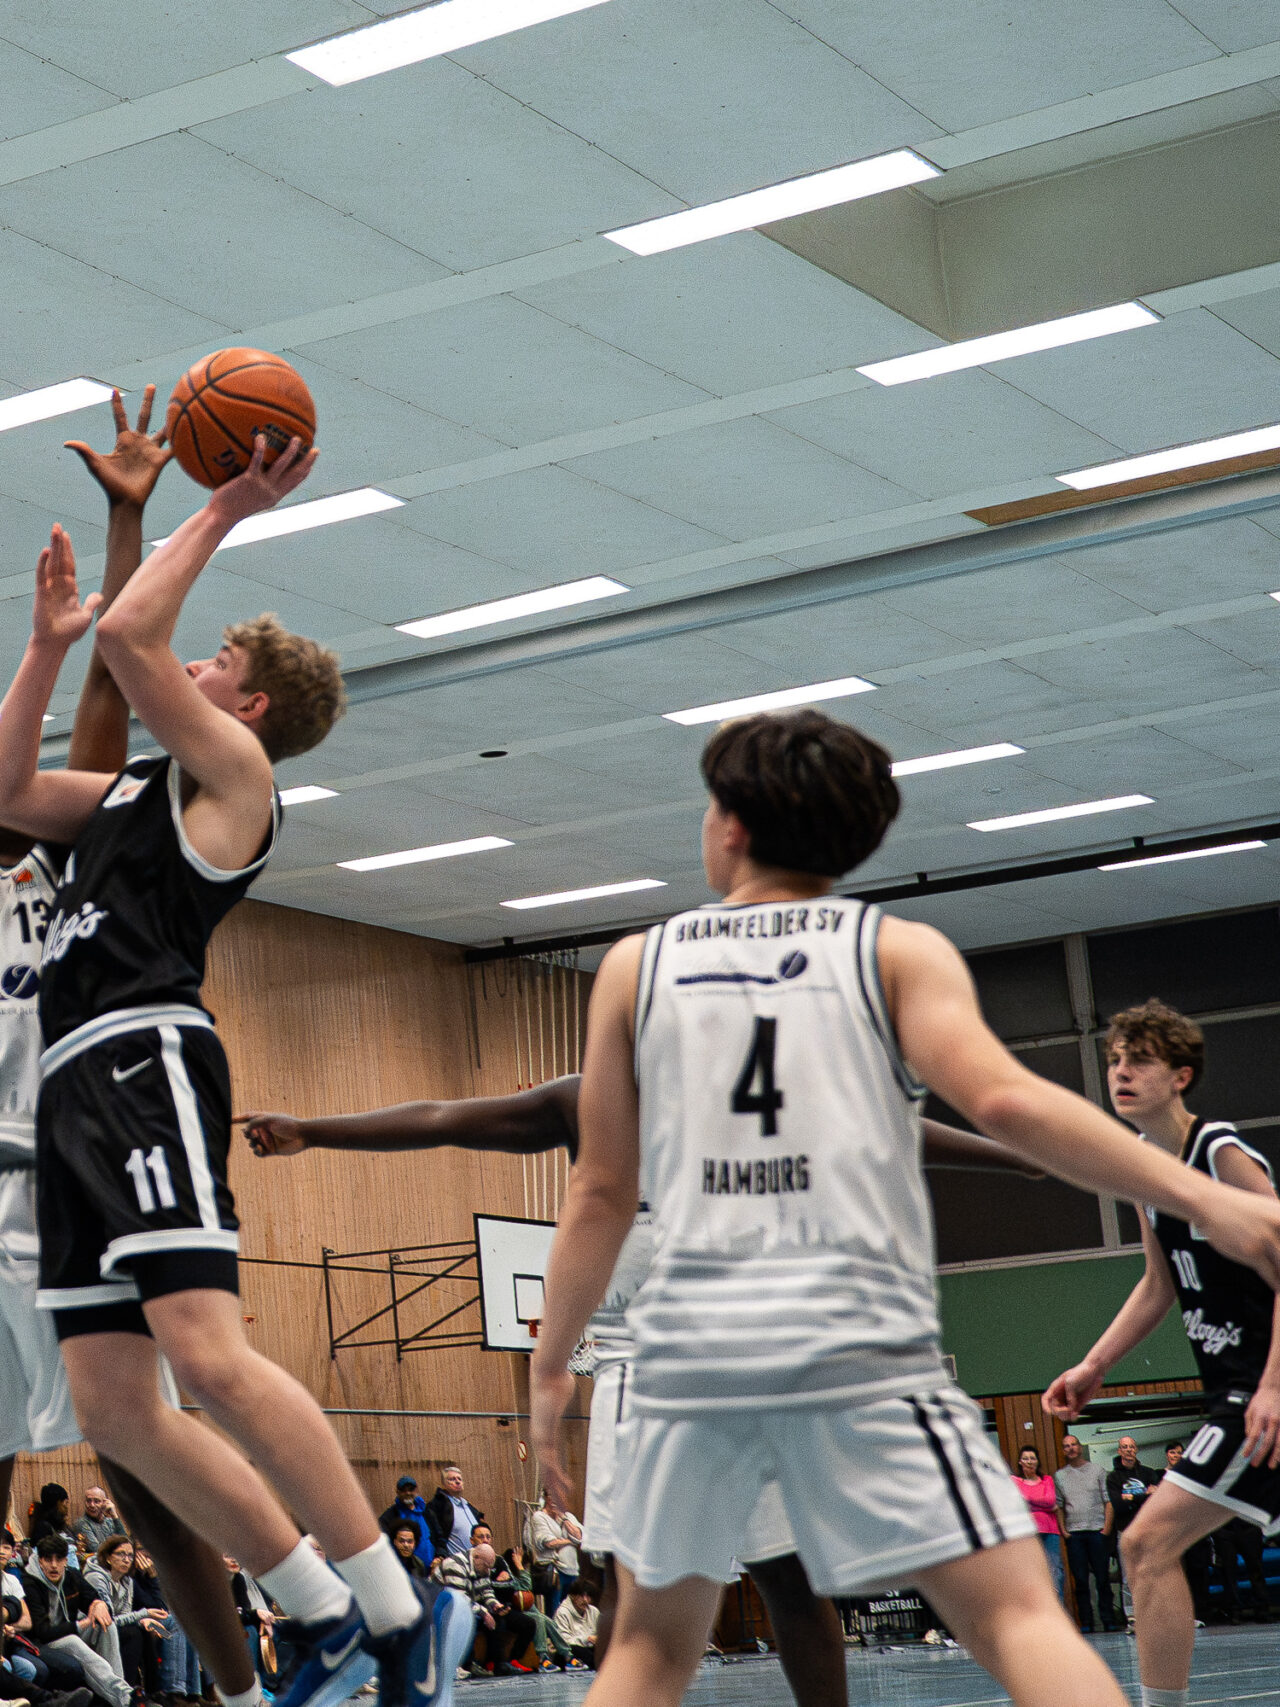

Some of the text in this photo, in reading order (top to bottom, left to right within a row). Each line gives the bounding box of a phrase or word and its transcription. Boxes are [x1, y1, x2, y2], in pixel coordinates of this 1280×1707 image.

[676, 908, 845, 943] BRAMFELDER SV
[730, 1015, 784, 1137] 4
[125, 1145, 177, 1214] 11
[702, 1154, 811, 1194] HAMBURG
[1171, 1249, 1202, 1291] 10
[1181, 1423, 1225, 1465] 10
[868, 1598, 923, 1613] BASKETBALL
